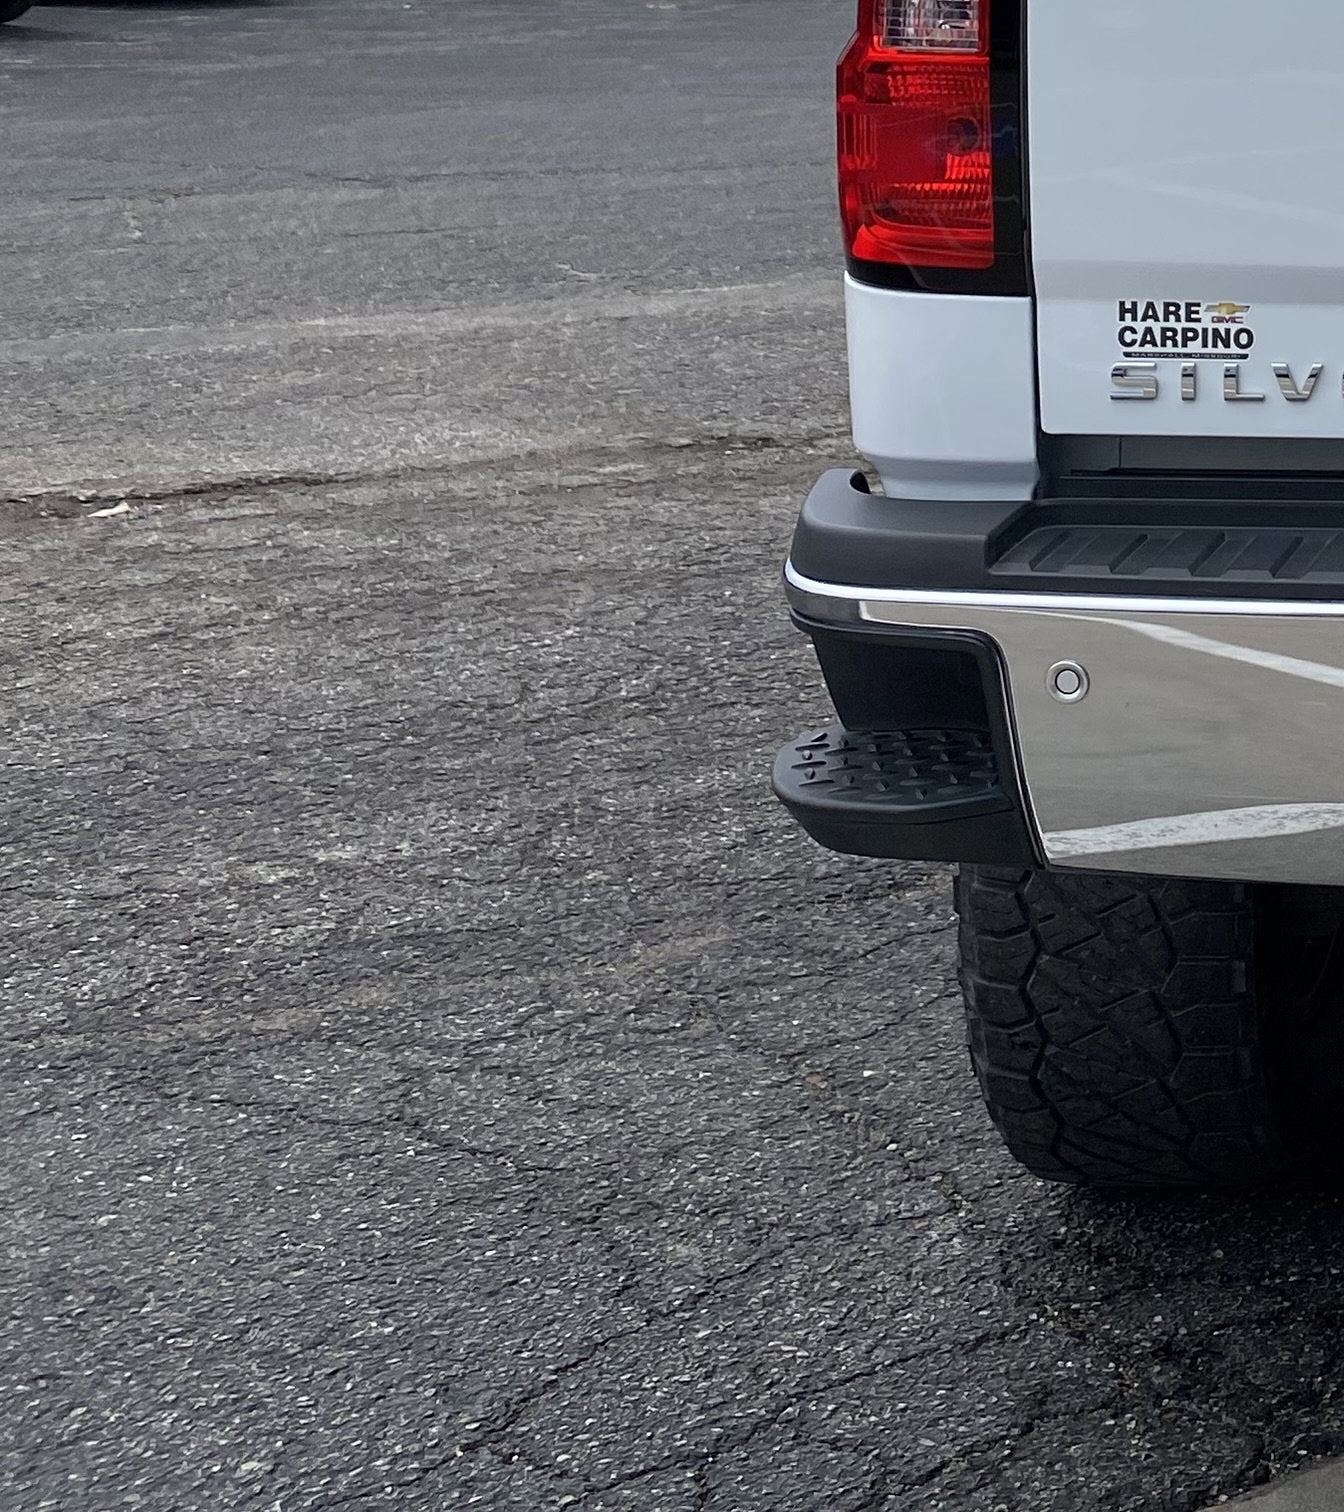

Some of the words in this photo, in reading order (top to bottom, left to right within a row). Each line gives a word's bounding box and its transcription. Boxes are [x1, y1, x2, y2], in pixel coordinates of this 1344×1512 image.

[1118, 300, 1202, 324] HARE
[1211, 315, 1244, 325] GMC
[1117, 325, 1255, 350] CARPINO
